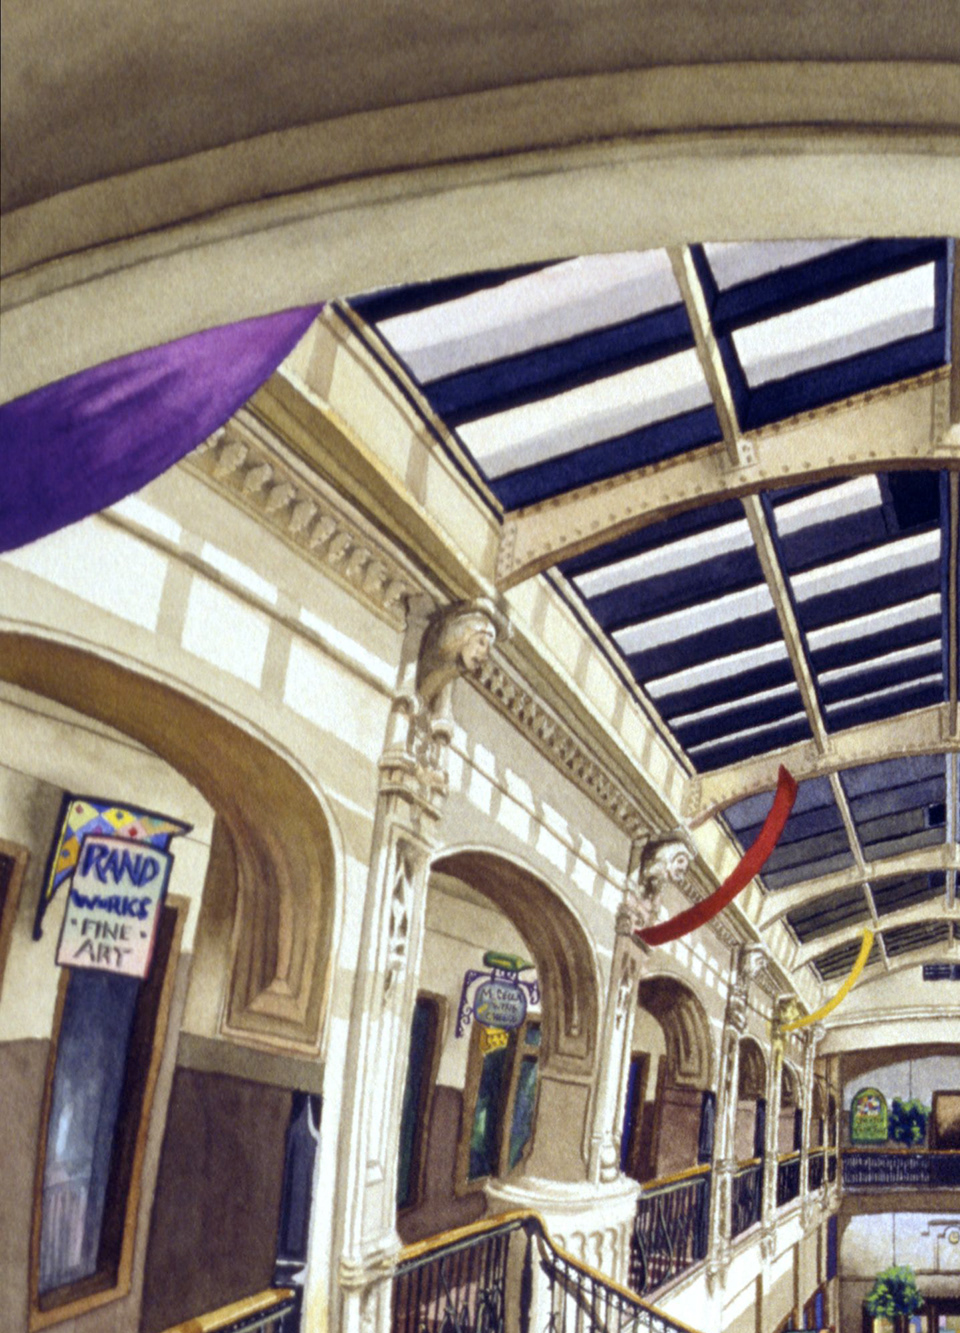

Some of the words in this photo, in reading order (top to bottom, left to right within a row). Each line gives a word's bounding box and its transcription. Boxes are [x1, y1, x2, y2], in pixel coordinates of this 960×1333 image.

[80, 843, 160, 887] RAND
[71, 888, 152, 920] WORKS
[80, 917, 132, 941] FINE
[72, 938, 134, 968] ART
